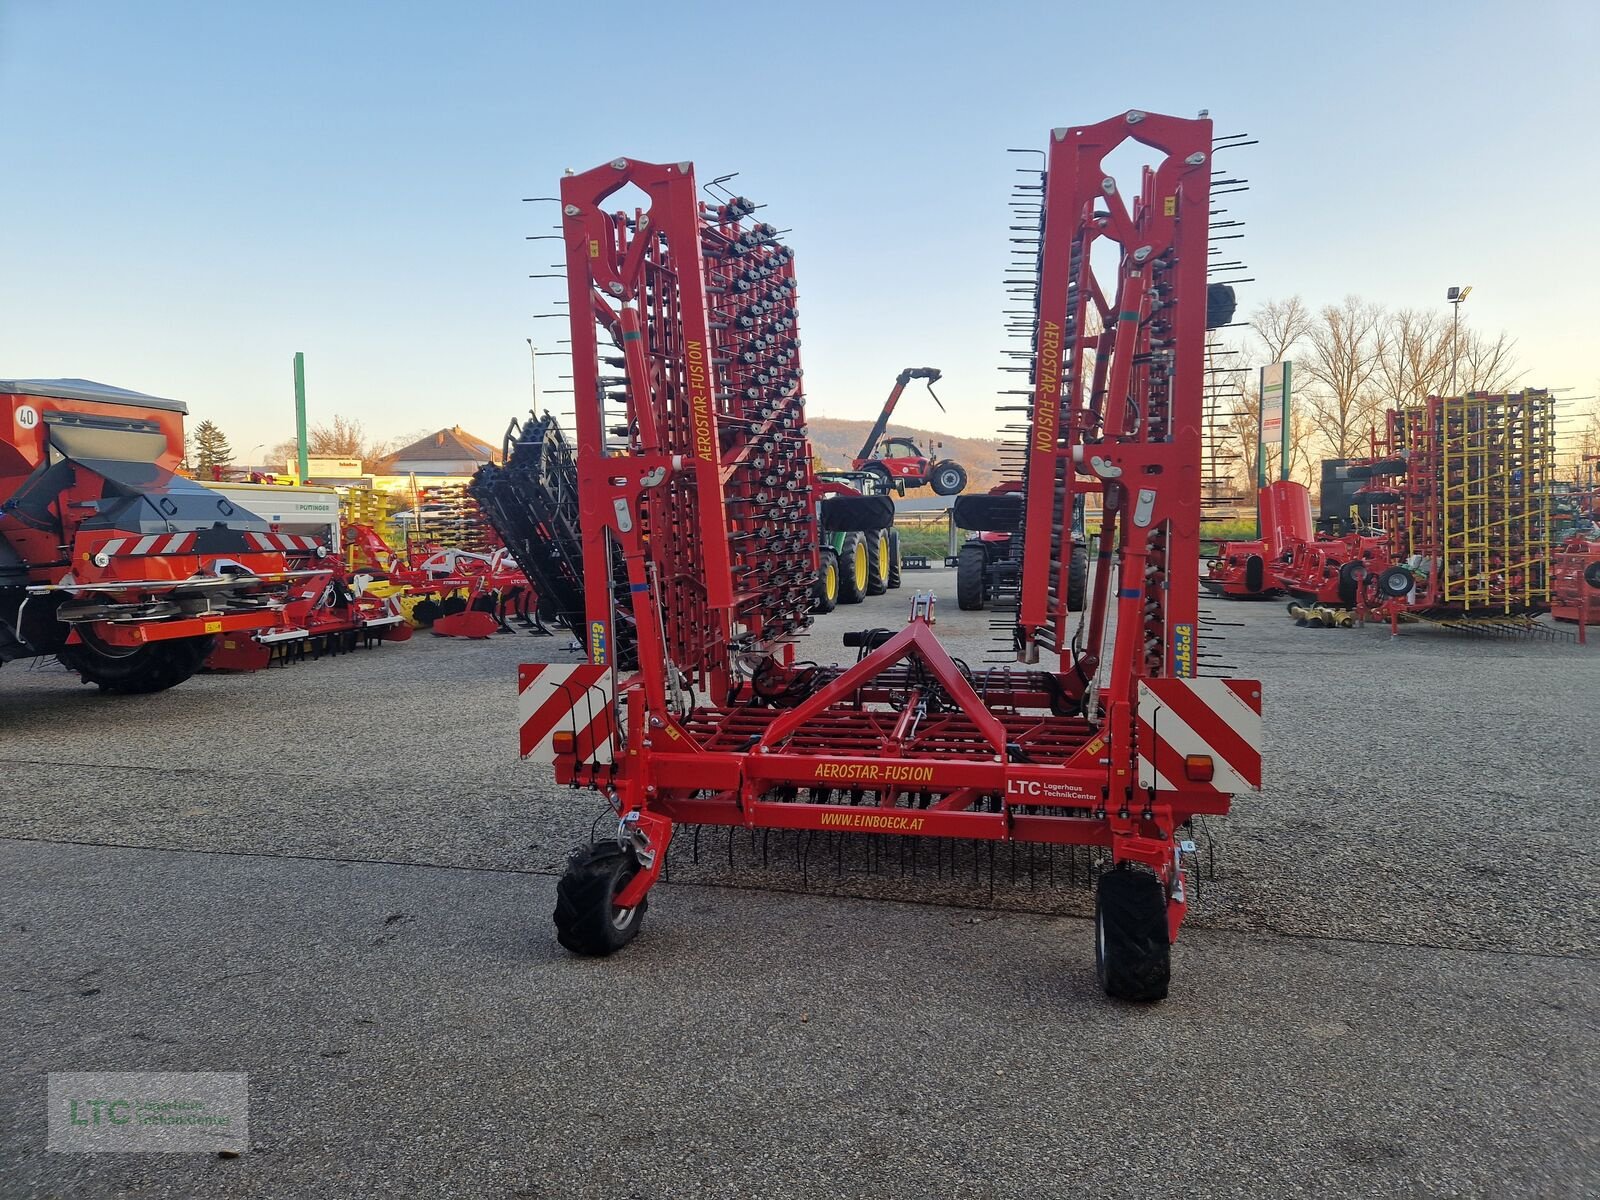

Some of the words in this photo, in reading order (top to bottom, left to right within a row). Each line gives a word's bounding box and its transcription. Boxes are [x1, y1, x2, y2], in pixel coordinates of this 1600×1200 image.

[1036, 320, 1060, 453] AEROSTAR-FUSION
[687, 341, 712, 461] AEROSTAR-FUSION
[20, 409, 34, 425] 40
[592, 622, 605, 665] Einbö
[1175, 625, 1191, 678] inböck
[815, 763, 934, 781] AEROSTAR-FUSION
[1007, 780, 1041, 796] LTC
[1043, 782, 1083, 791] Lagerhaus
[1043, 790, 1097, 800] TechnikCenter
[821, 813, 925, 831] WWW.EINBOECK.AT
